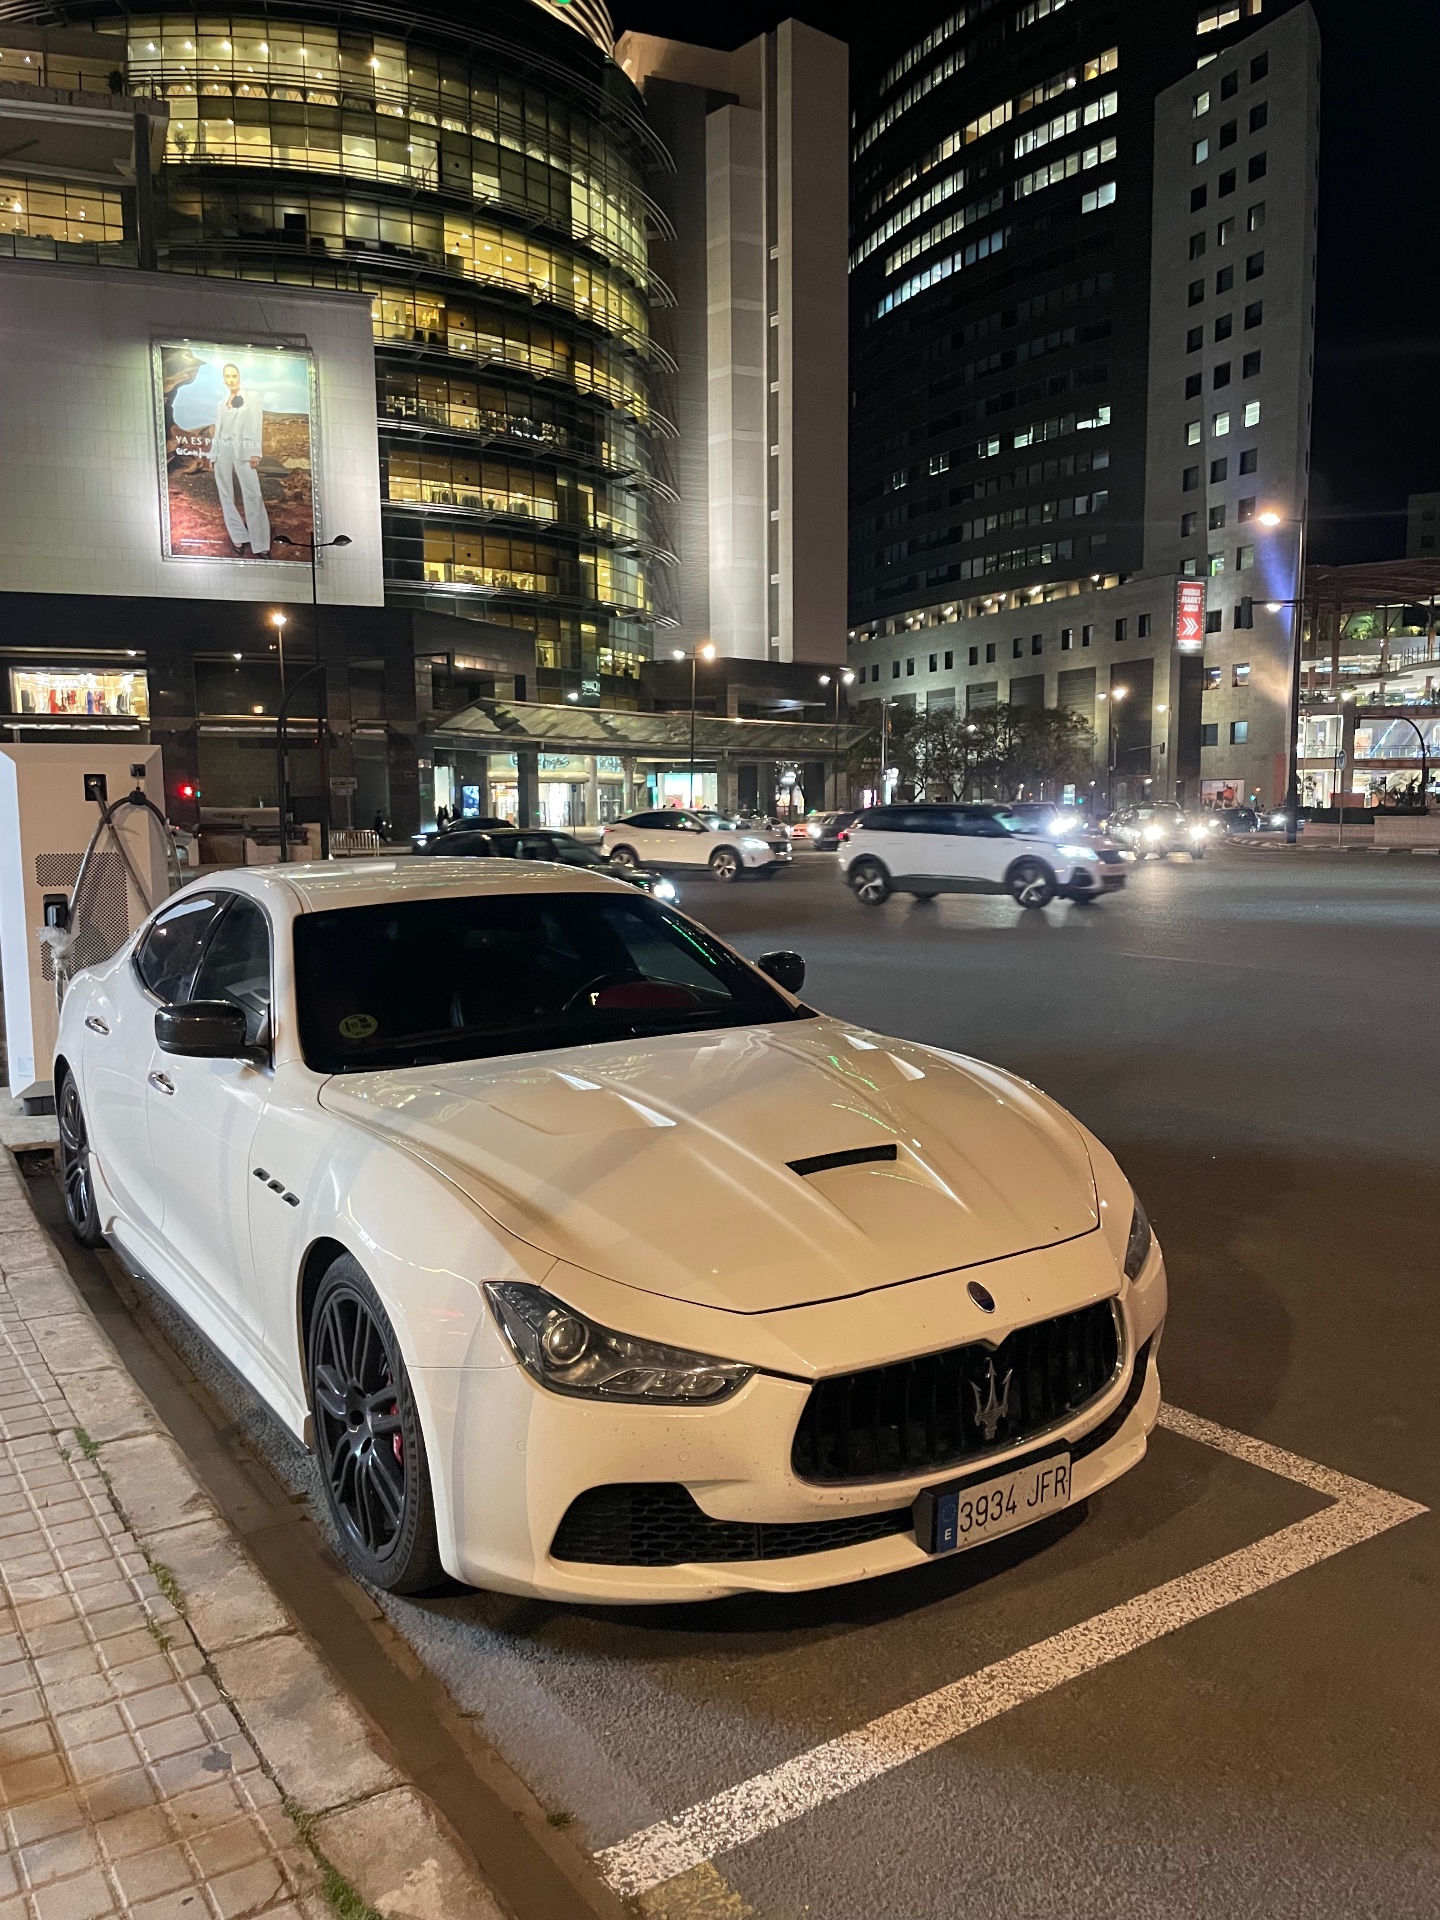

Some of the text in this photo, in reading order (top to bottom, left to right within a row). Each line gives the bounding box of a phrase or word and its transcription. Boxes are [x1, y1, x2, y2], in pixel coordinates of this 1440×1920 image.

[175, 436, 188, 445] YA
[191, 437, 202, 446] ES
[1183, 588, 1200, 596] MEDIA
[1181, 596, 1201, 604] MARKT
[1183, 604, 1198, 612] AQUA
[960, 1466, 1066, 1532] 3934 JFR
[945, 1528, 952, 1540] E
